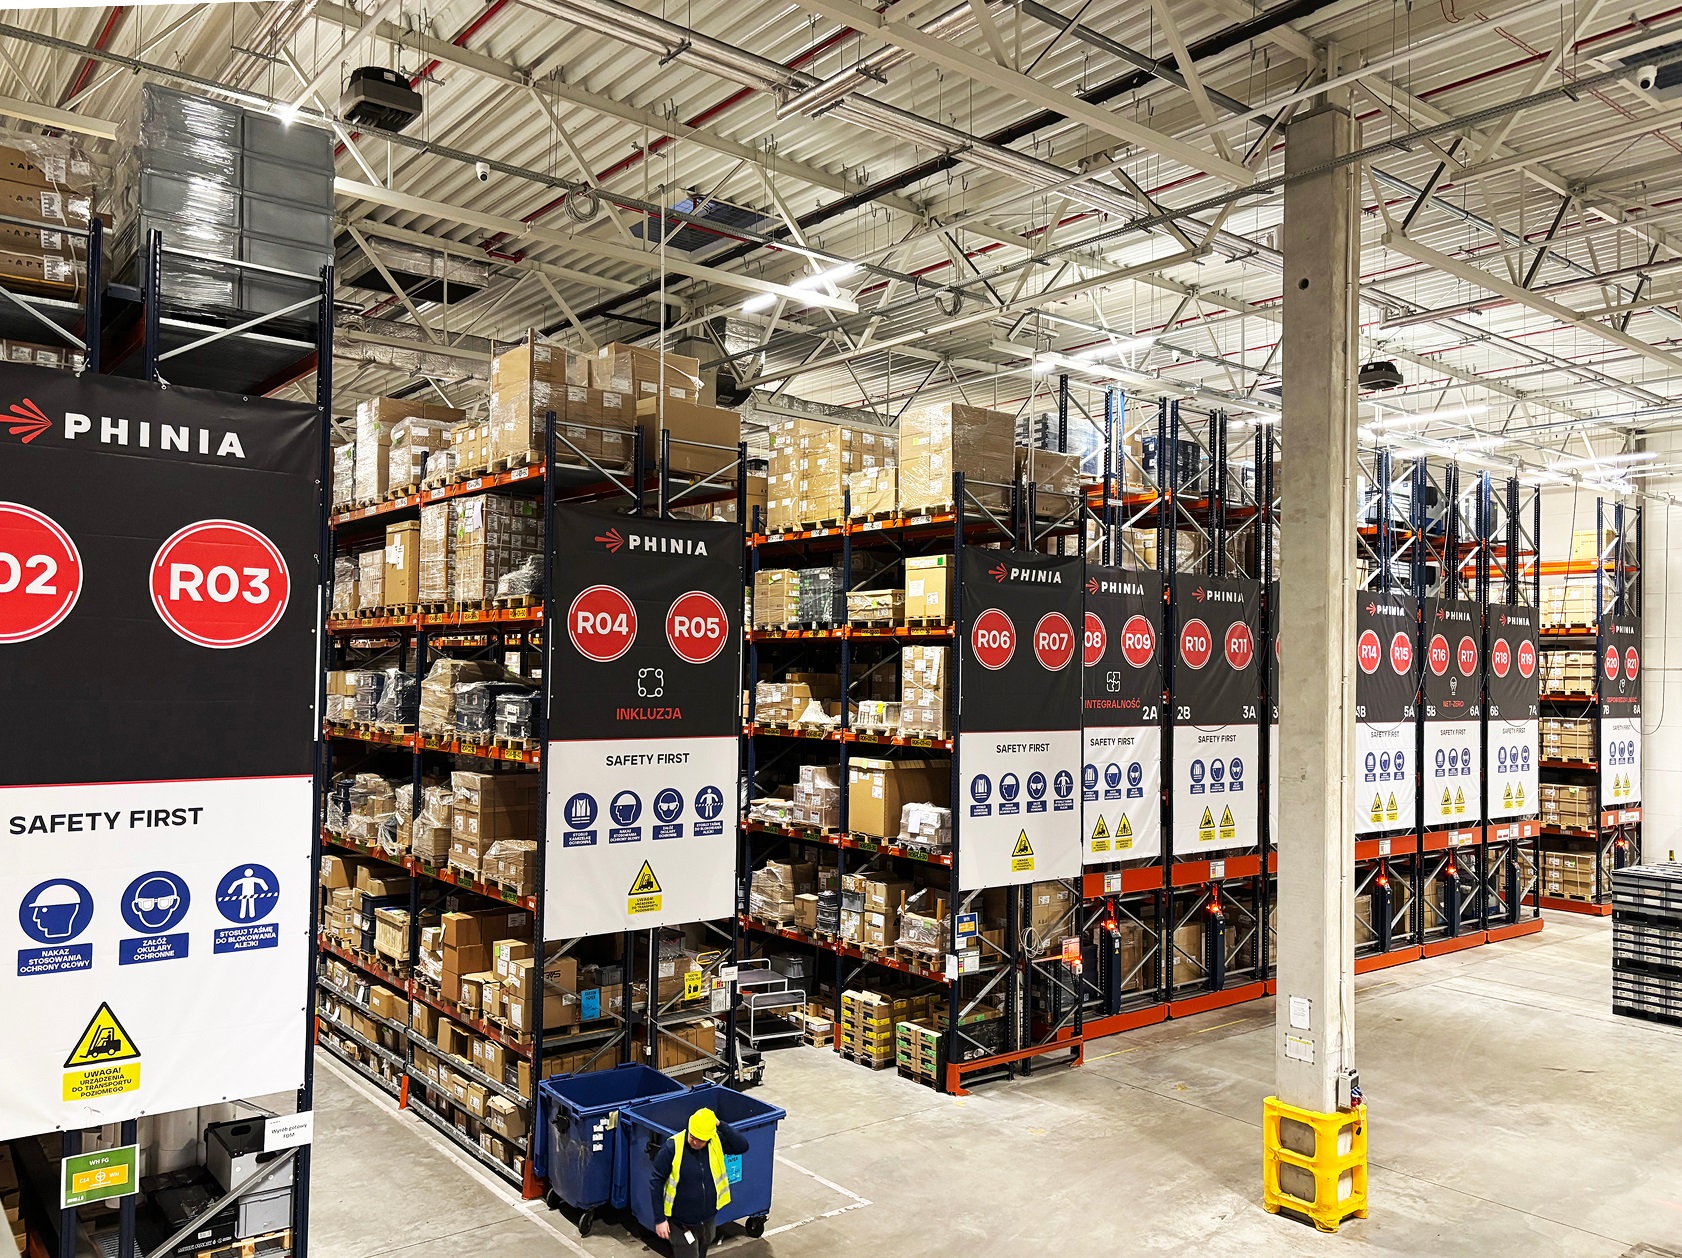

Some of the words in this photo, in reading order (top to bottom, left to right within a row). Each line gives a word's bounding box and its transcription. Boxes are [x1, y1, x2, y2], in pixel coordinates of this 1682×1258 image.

[64, 412, 246, 458] PHINIA
[628, 534, 708, 556] PHINIA
[0, 552, 58, 595] 02
[1010, 567, 1062, 584] PHINIA
[169, 563, 270, 604] R03
[1101, 581, 1144, 595] PHINIA
[1206, 590, 1245, 603] PHINIA
[1376, 604, 1405, 617] PHINIA
[1445, 610, 1471, 621] PHINIA
[576, 611, 629, 635] R04
[674, 615, 720, 639] R05
[1506, 616, 1530, 627] PHINIA
[1615, 625, 1635, 634] PHINIA
[977, 629, 1011, 649] R06
[1038, 632, 1069, 651] R07
[1084, 631, 1102, 648] 08
[1125, 633, 1151, 650] R09
[1185, 636, 1206, 652] R10
[1230, 638, 1247, 653] R11
[1361, 645, 1377, 659] R14
[1394, 646, 1409, 660] R15
[1432, 649, 1446, 662] R16
[1461, 650, 1474, 663] R17
[1495, 652, 1508, 665] R18
[1520, 653, 1533, 665] R19
[1606, 657, 1617, 668] R20
[1627, 658, 1637, 669] R21
[1084, 698, 1140, 709] INTEGRALNOŚĆ
[1602, 705, 1610, 715] 7B
[616, 707, 683, 720] INKLUZJA
[1142, 706, 1158, 720] 2A
[1177, 706, 1191, 720] 2B
[1242, 706, 1256, 719] 3A
[1272, 706, 1279, 719] 3
[1403, 705, 1415, 718] 5A
[1426, 705, 1436, 717] 5B
[1469, 705, 1480, 717] 6A
[1387, 730, 1400, 738] FIRST
[1455, 728, 1466, 736] FIRST
[1502, 727, 1515, 735] SAFETY
[1090, 738, 1116, 746] SAFETY
[1117, 737, 1135, 746] FIRST
[1197, 735, 1220, 744] SAFETY
[1221, 734, 1237, 743] FIRST
[996, 744, 1027, 753] SAFETY
[1029, 743, 1050, 753] FIRST
[605, 754, 654, 767] SAFETY
[656, 753, 690, 765] FIRST
[9, 811, 121, 835] SAFETY
[129, 807, 204, 829] FIRST
[219, 928, 248, 938] STOSUJ
[248, 925, 274, 934] TAŚMĘ
[142, 936, 167, 946] ZAŁÓŻ
[215, 937, 226, 945] DO
[227, 932, 277, 943] BLOKOWANIA
[233, 941, 259, 949] ALEJKI
[41, 948, 70, 957] NAKAZ
[133, 950, 175, 961] OCHRONNE
[137, 944, 172, 954] OKULARY
[20, 962, 60, 973] OCHRONY
[61, 960, 90, 969] GŁOWY
[28, 954, 82, 966] STOSOWANIA
[79, 1074, 125, 1085] URZĄDZENIA
[83, 1067, 122, 1079] UWAGA!
[84, 1079, 132, 1091] TRANSPORTU
[80, 1086, 124, 1098] POZIOMEGO
